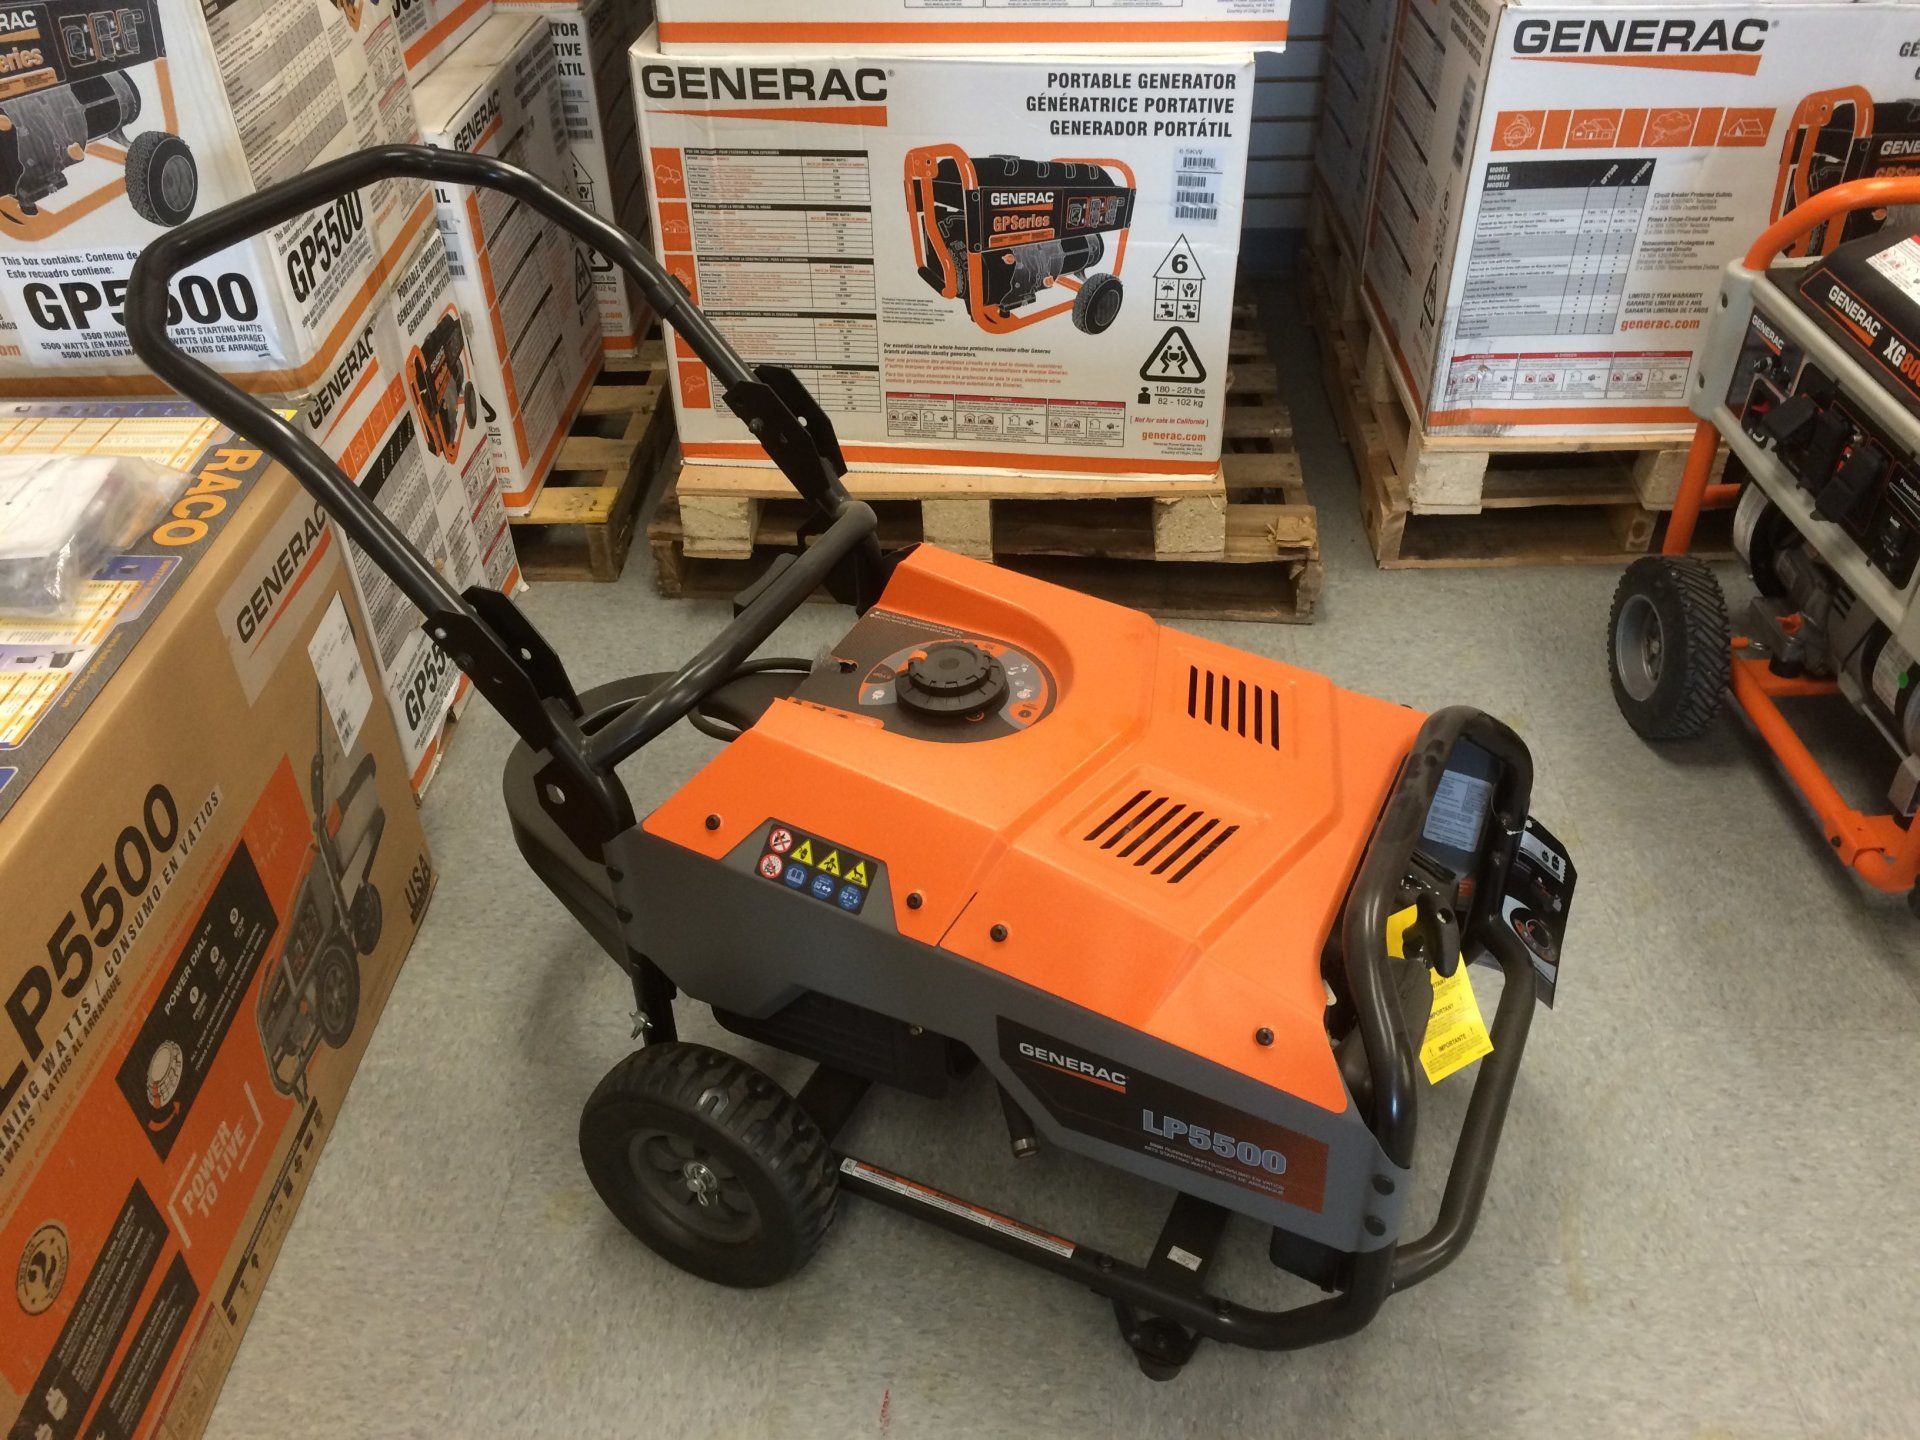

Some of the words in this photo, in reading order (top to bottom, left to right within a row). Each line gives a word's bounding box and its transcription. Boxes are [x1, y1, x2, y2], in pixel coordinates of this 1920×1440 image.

[1513, 18, 1769, 54] GENERAC
[641, 65, 888, 102] GENERAC
[1047, 73, 1132, 89] PORTABLE
[1138, 73, 1236, 90] GENERATOR
[1026, 92, 1138, 113] GÉNÉRATRICE
[1144, 97, 1234, 114] PORTATIVE
[1050, 120, 1148, 135] GENERADOR
[1153, 118, 1232, 137] PORTÁTIL
[990, 192, 1054, 206] GENERAC
[993, 215, 1050, 232] GPSeries
[287, 189, 363, 303] GP5500
[1, 257, 21, 266] This
[23, 257, 39, 265] box
[41, 254, 84, 265] contains:
[85, 252, 125, 263] Contenu
[127, 252, 138, 261] de
[1171, 254, 1188, 274] 6
[7, 269, 26, 279] Este
[29, 268, 69, 278] recuadro
[72, 266, 114, 277] contiene:
[1828, 285, 1881, 337] GENERAC
[81, 333, 102, 341] 5500
[175, 327, 195, 335] 6875
[198, 325, 236, 334] STARTING
[237, 324, 262, 333] WATTS
[1621, 320, 1700, 331] generac.com
[1752, 315, 1785, 350] GENERAC
[41, 342, 61, 350] 5500
[63, 341, 90, 349] WATTS
[92, 341, 107, 350] (EN
[200, 336, 214, 345] (AU
[61, 350, 82, 358] 5500
[84, 349, 110, 358] VATIOS
[187, 345, 214, 354] VATIOS
[215, 344, 227, 352] DE
[228, 342, 268, 352] ARRANQUE
[307, 326, 374, 430] GENERAC
[1177, 386, 1192, 394] 225
[1193, 399, 1204, 408] kg
[1142, 432, 1206, 442] generac.com
[153, 449, 264, 547] RACO
[235, 501, 328, 643] GENERAC
[41, 997, 92, 1077] WATTS
[104, 886, 162, 979] CONSUMO
[163, 859, 180, 886] EN
[179, 790, 220, 860] VATIOS
[164, 965, 192, 1016] POWER
[1429, 1003, 1454, 1019] MPORTANT
[1438, 1034, 1466, 1051] IMPORTANTE
[3, 1114, 36, 1165] WATTS
[41, 1057, 73, 1102] VATIOS
[73, 1037, 84, 1056] AL
[84, 974, 122, 1038] ARRANQUE
[1019, 1042, 1127, 1086] GENERAC
[1143, 1109, 1287, 1175] LP5500
[181, 1121, 232, 1216] POWER
[196, 1187, 219, 1218] TO
[218, 1123, 247, 1184] LIVE
